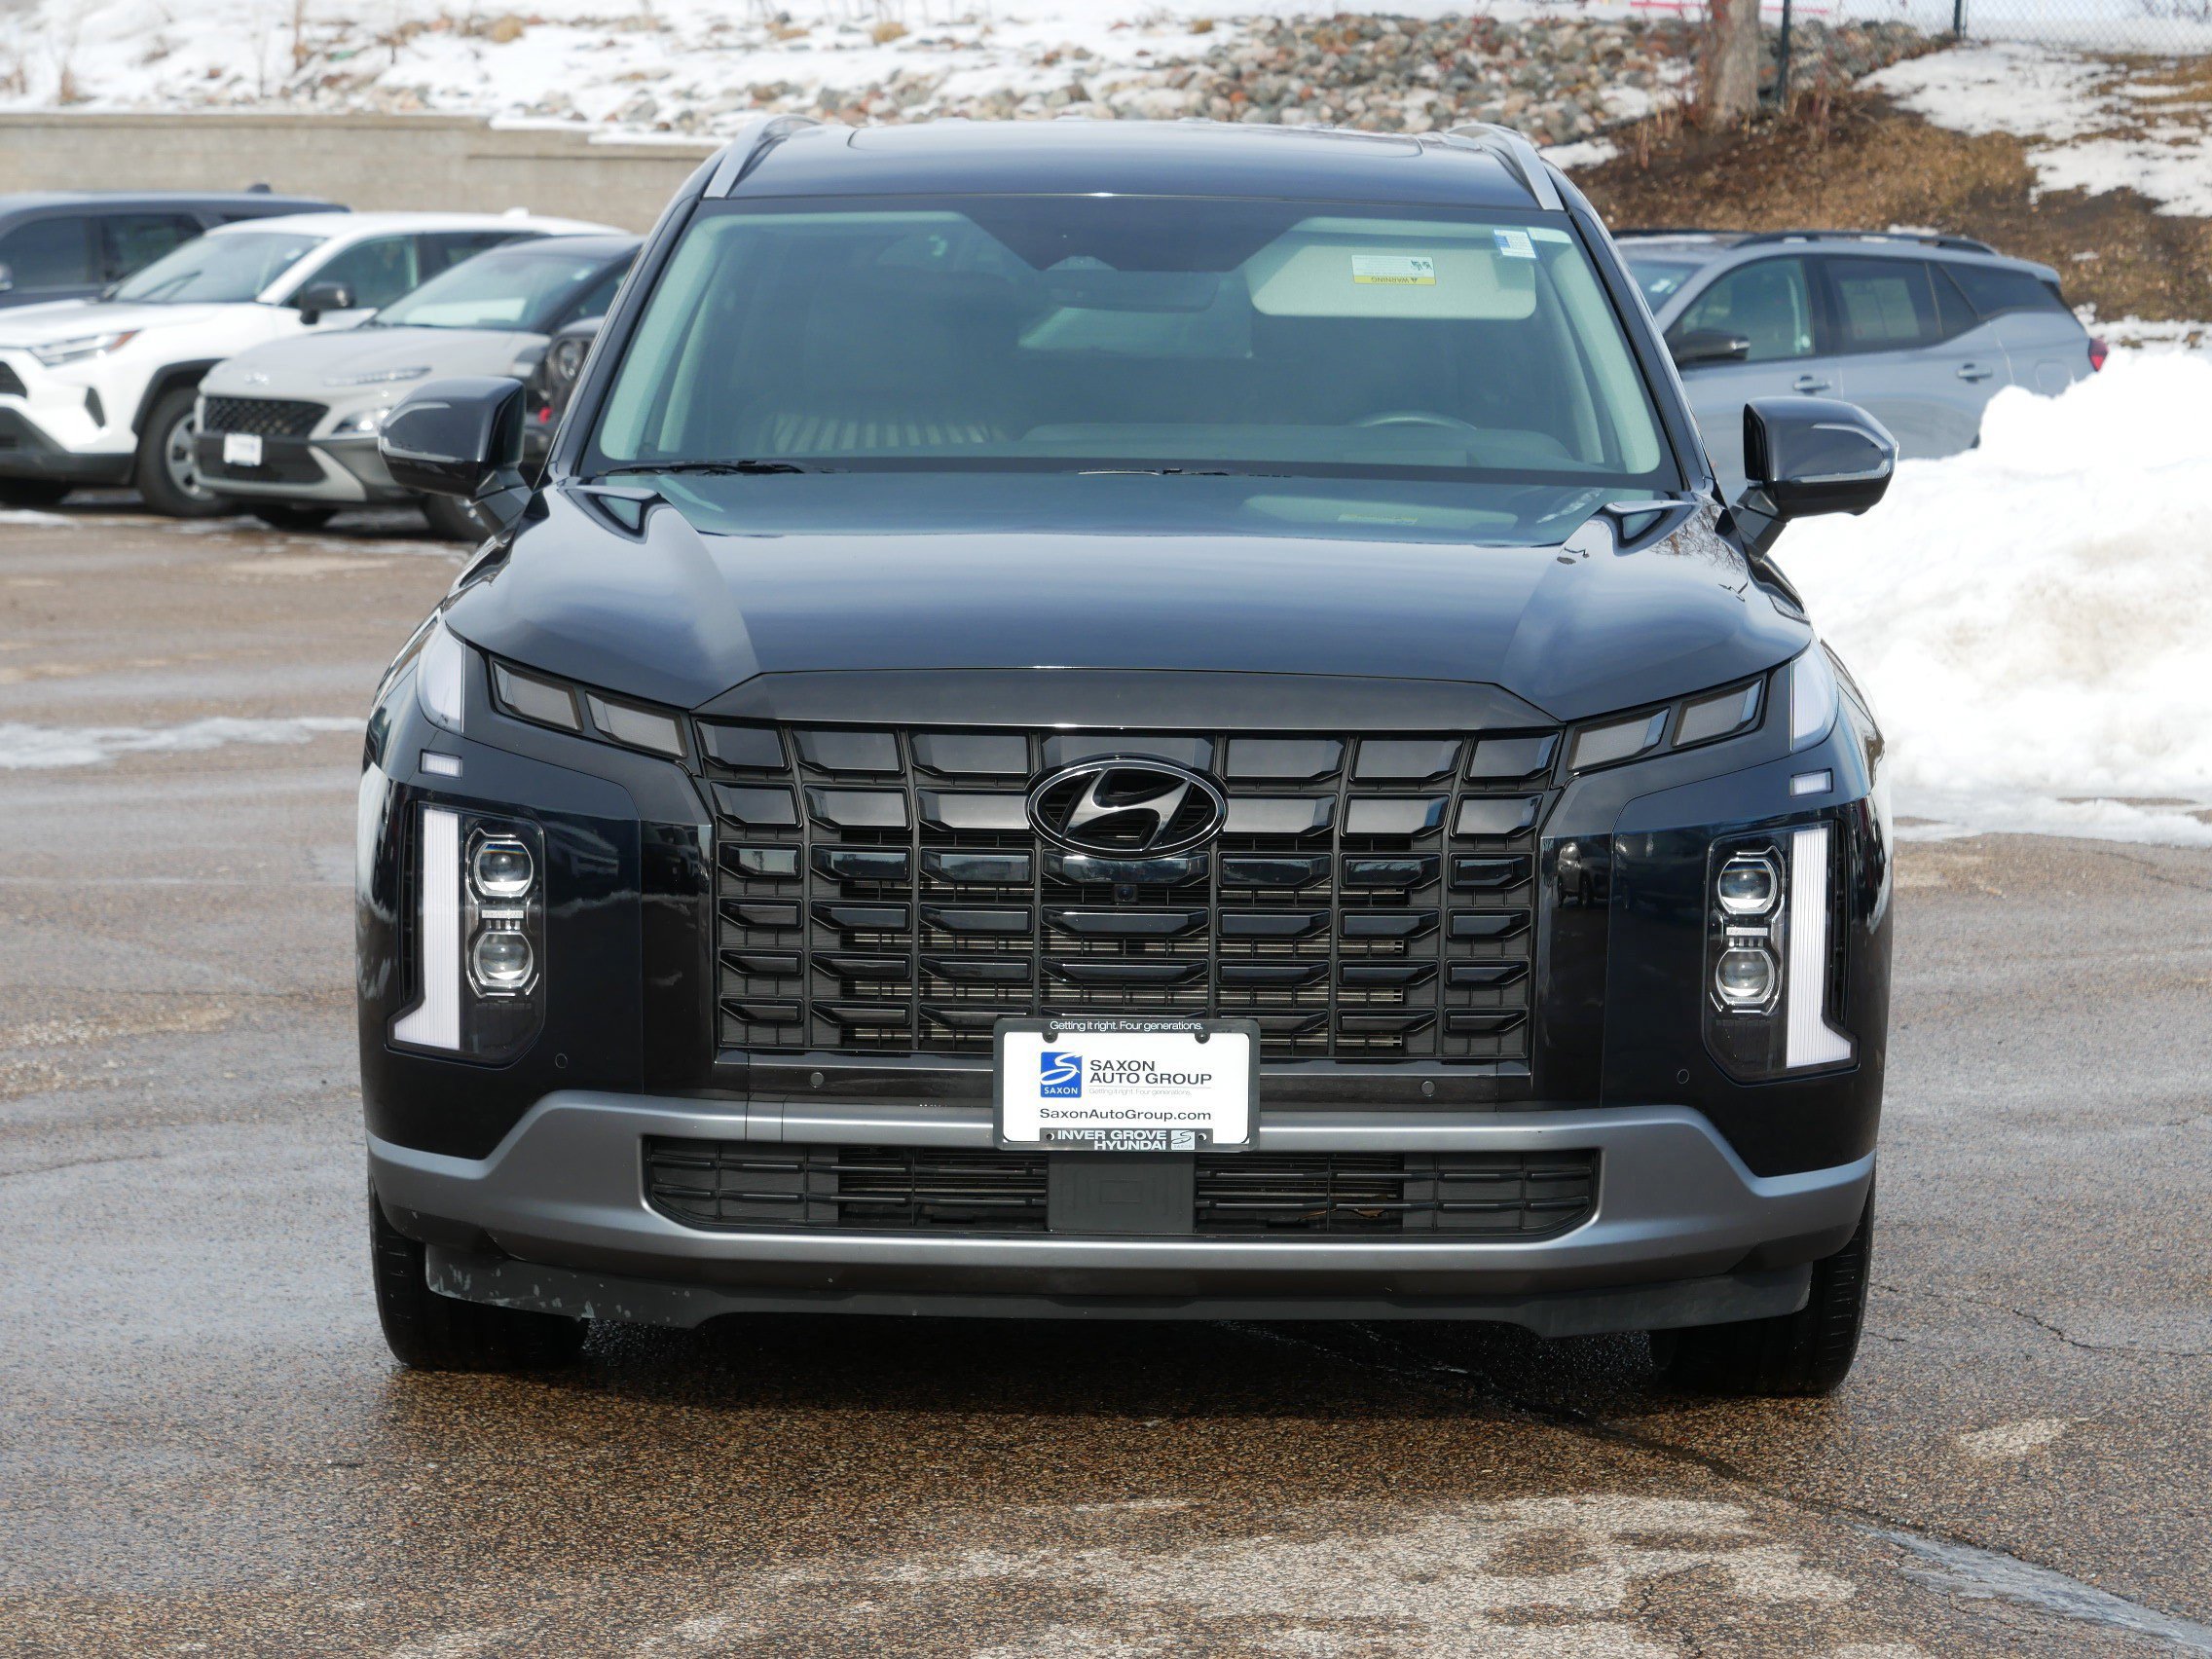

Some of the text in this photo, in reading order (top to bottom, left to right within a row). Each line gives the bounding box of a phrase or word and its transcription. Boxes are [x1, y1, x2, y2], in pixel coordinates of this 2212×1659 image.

[1050, 1020, 1203, 1032] Getting it right. Four generations.
[1089, 1059, 1156, 1072] SAXON
[1089, 1072, 1212, 1085] AUTO GROUP
[1044, 1087, 1079, 1095] SAXON
[1088, 1088, 1114, 1096] Getting
[1040, 1108, 1212, 1122] SaxonAutoGroup.com
[1057, 1129, 1167, 1140] INVER GROVE
[1094, 1140, 1166, 1151] HYUNDAI
